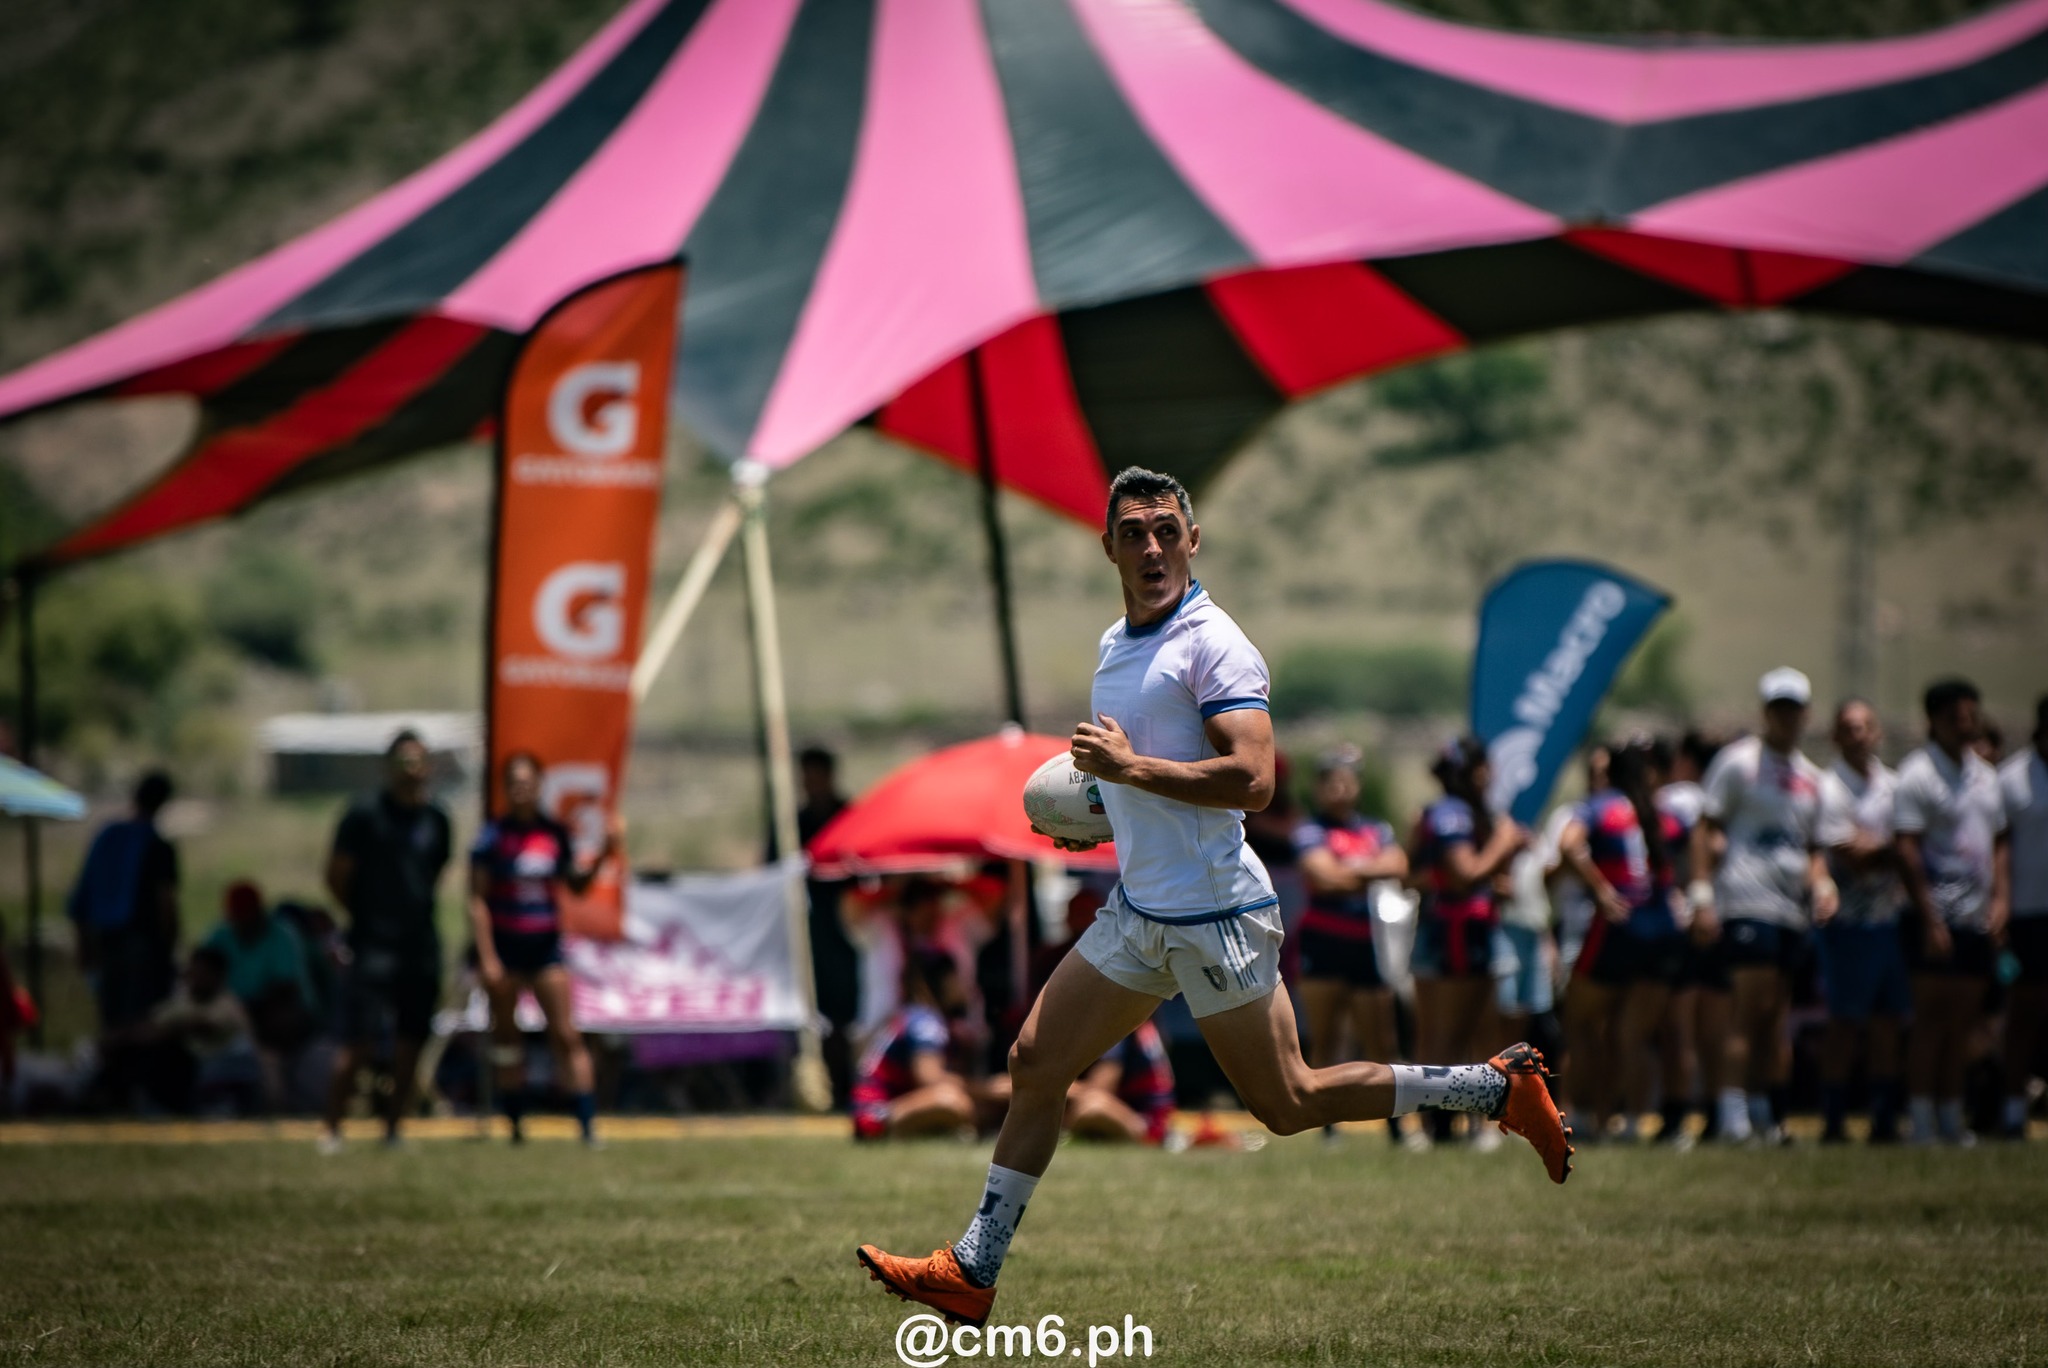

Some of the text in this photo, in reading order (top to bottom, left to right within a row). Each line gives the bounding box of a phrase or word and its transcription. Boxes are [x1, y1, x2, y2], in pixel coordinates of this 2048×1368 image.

[547, 361, 641, 455] G
[533, 561, 627, 656] G
[1069, 771, 1096, 785] UGBY
